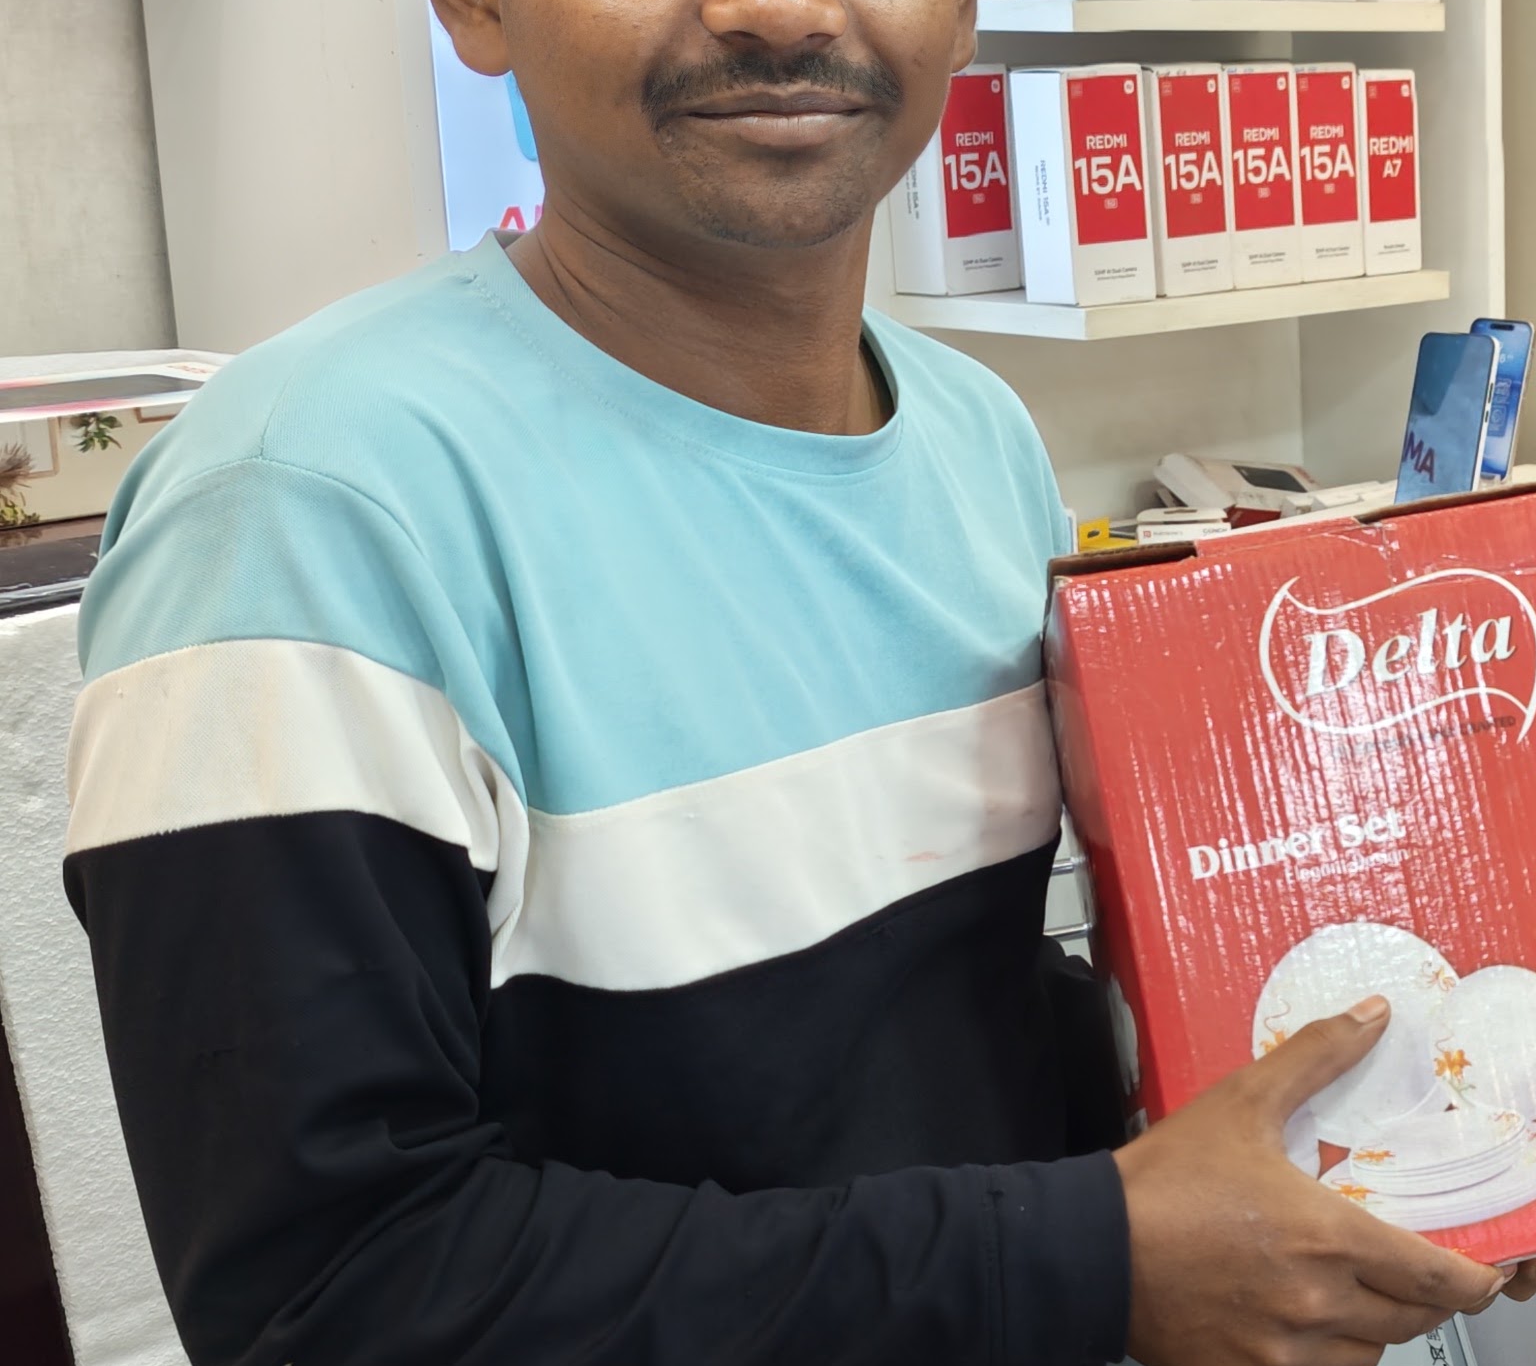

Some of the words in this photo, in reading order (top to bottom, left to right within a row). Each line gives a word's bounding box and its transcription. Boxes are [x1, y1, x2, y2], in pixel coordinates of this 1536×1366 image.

[956, 131, 995, 147] REDMI
[1086, 133, 1128, 151] REDMI
[1175, 131, 1211, 147] REDMI
[1243, 127, 1280, 143] REDMI
[1309, 124, 1344, 140] REDMI
[1368, 136, 1414, 156] REDMI
[944, 150, 1007, 191] 15A
[1074, 154, 1143, 196] 15A
[1164, 150, 1223, 191] 15A
[1233, 146, 1292, 185] 15A
[1300, 143, 1356, 182] 15A
[1382, 158, 1403, 179] A7
[1303, 607, 1516, 698] Delta
[1187, 825, 1327, 881] Dinner
[1337, 806, 1408, 849] Set
